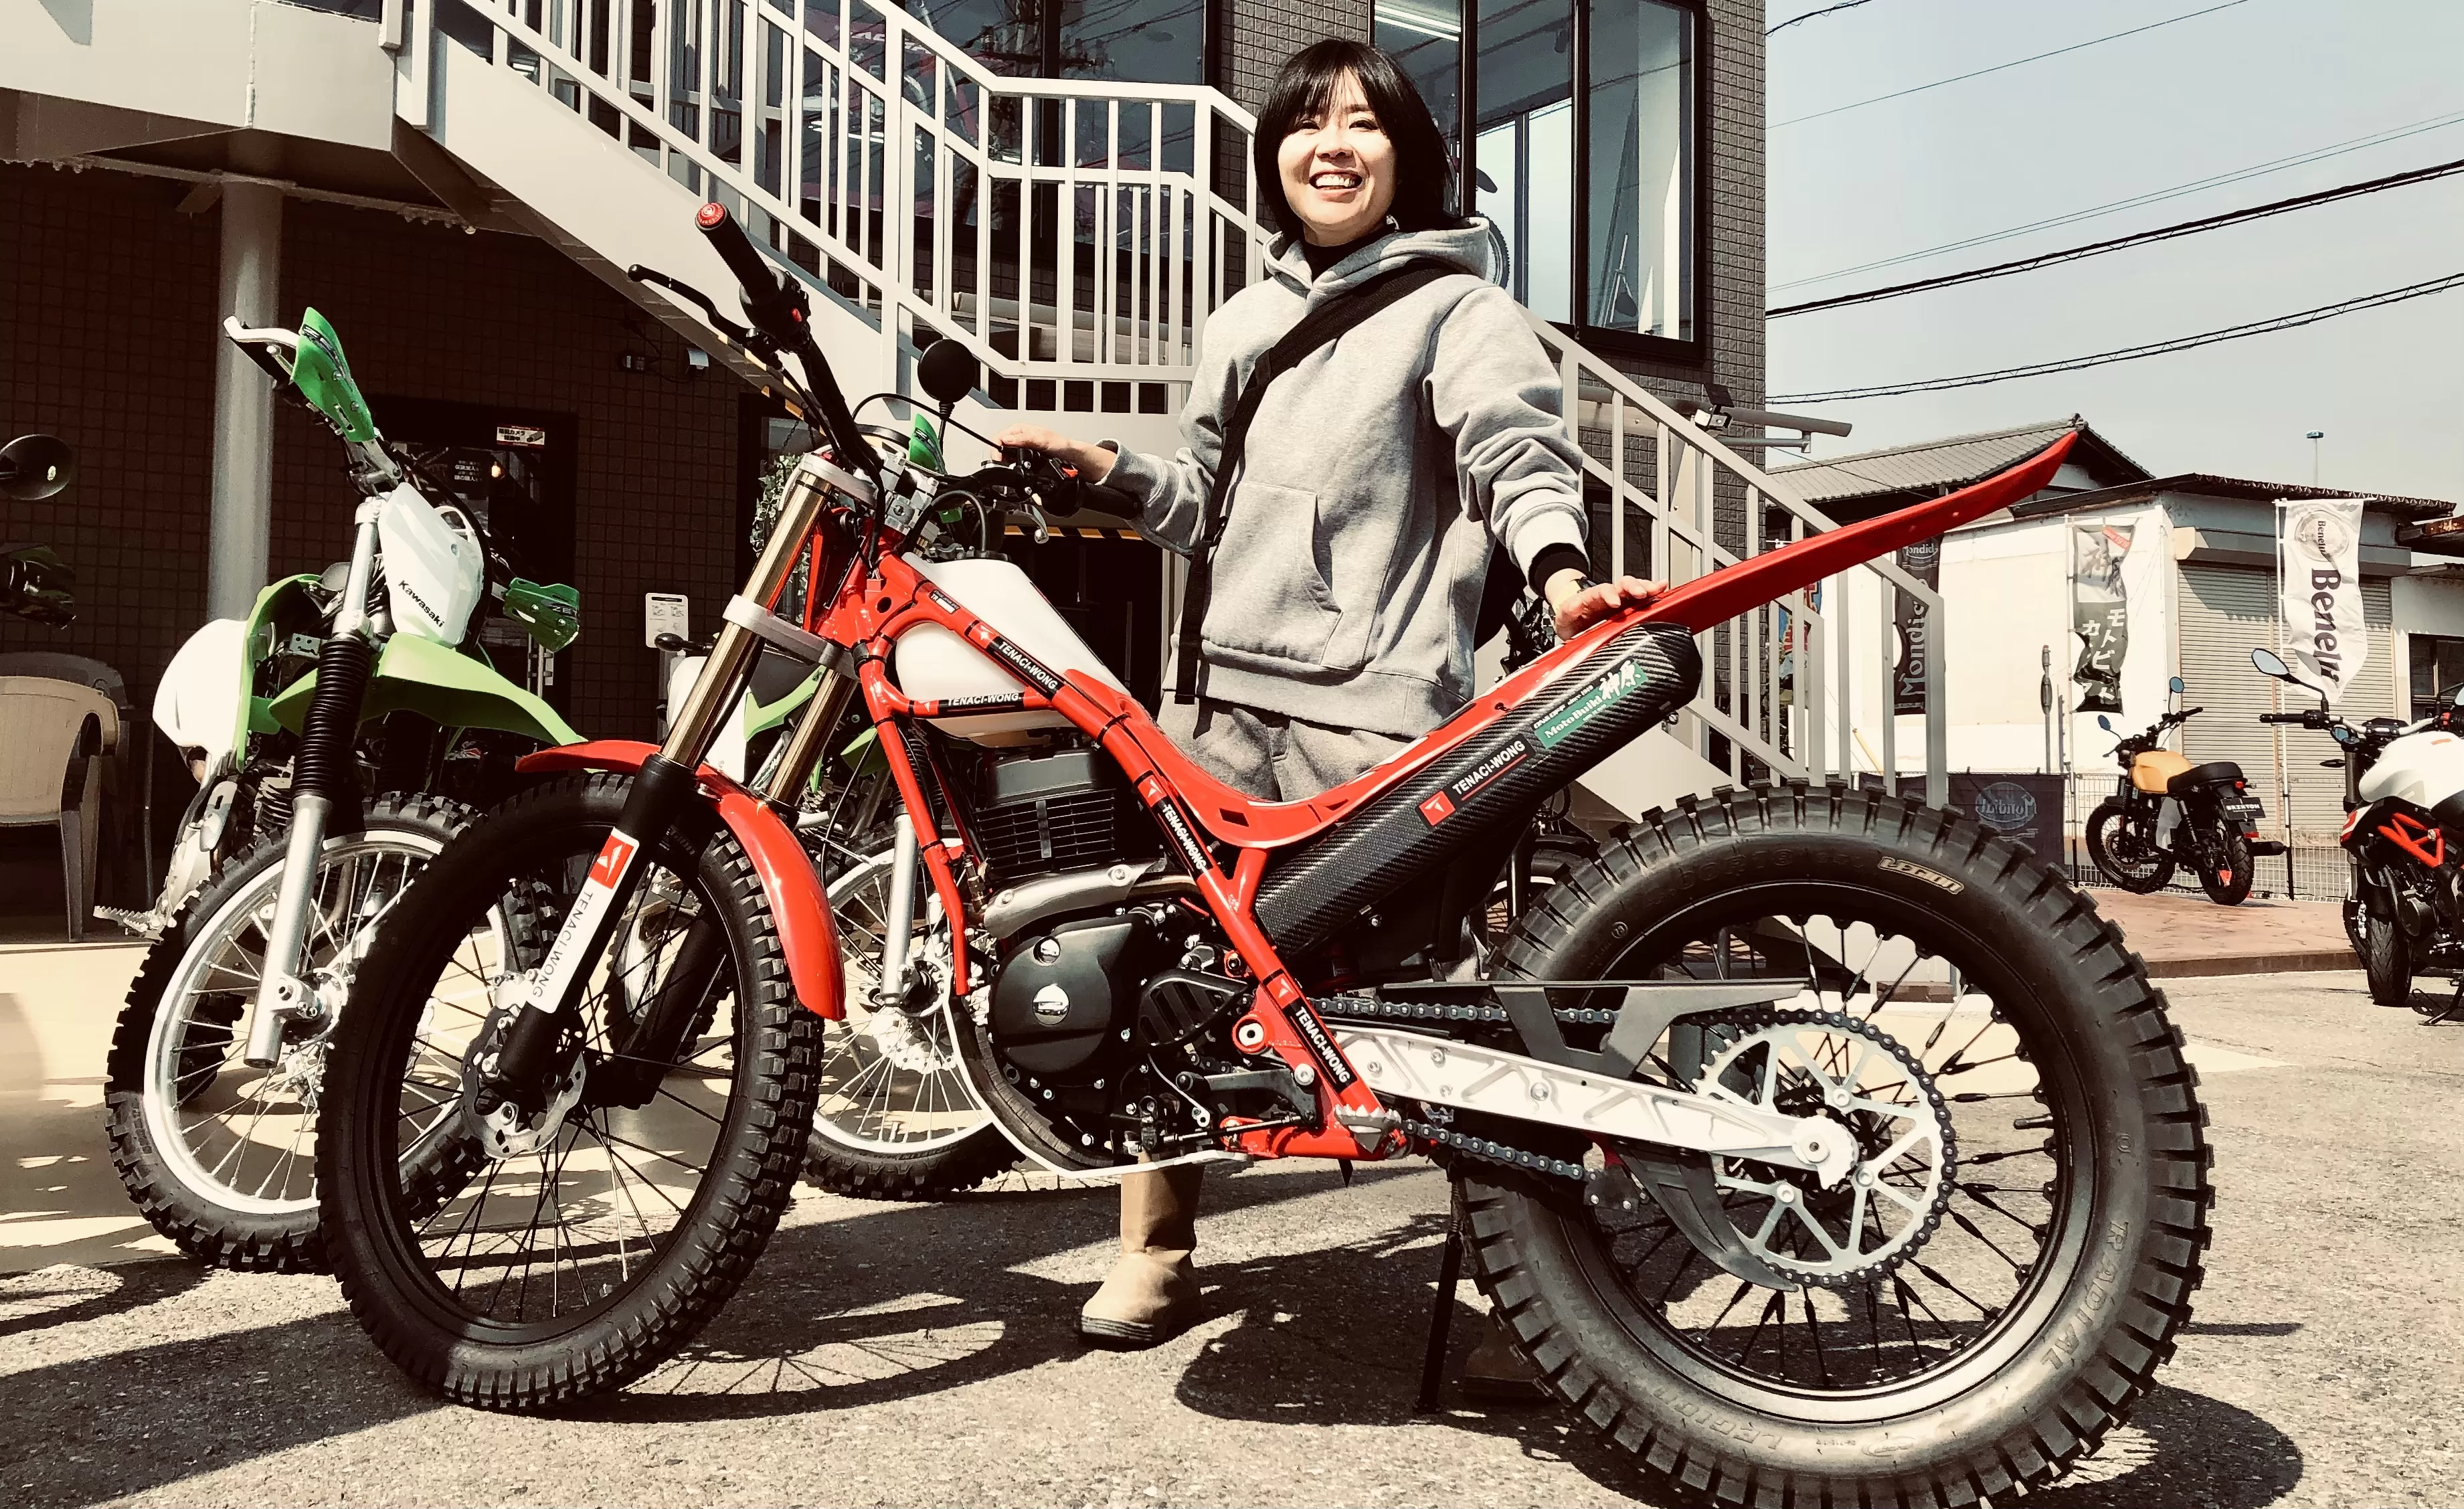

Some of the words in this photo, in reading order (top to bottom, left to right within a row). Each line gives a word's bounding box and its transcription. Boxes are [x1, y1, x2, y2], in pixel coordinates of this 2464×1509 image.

[398, 580, 445, 628] Kawasaki
[998, 641, 1057, 689] TENACI-WONG
[947, 693, 1020, 707] TENACI-WONG
[1545, 695, 1603, 738] MotoBuild
[1452, 740, 1525, 794] TENACI-WONG
[1162, 804, 1207, 870] TENACI-WONG
[533, 891, 594, 997] TENACI-WONG
[1295, 1006, 1350, 1083] TENACI-WONG
